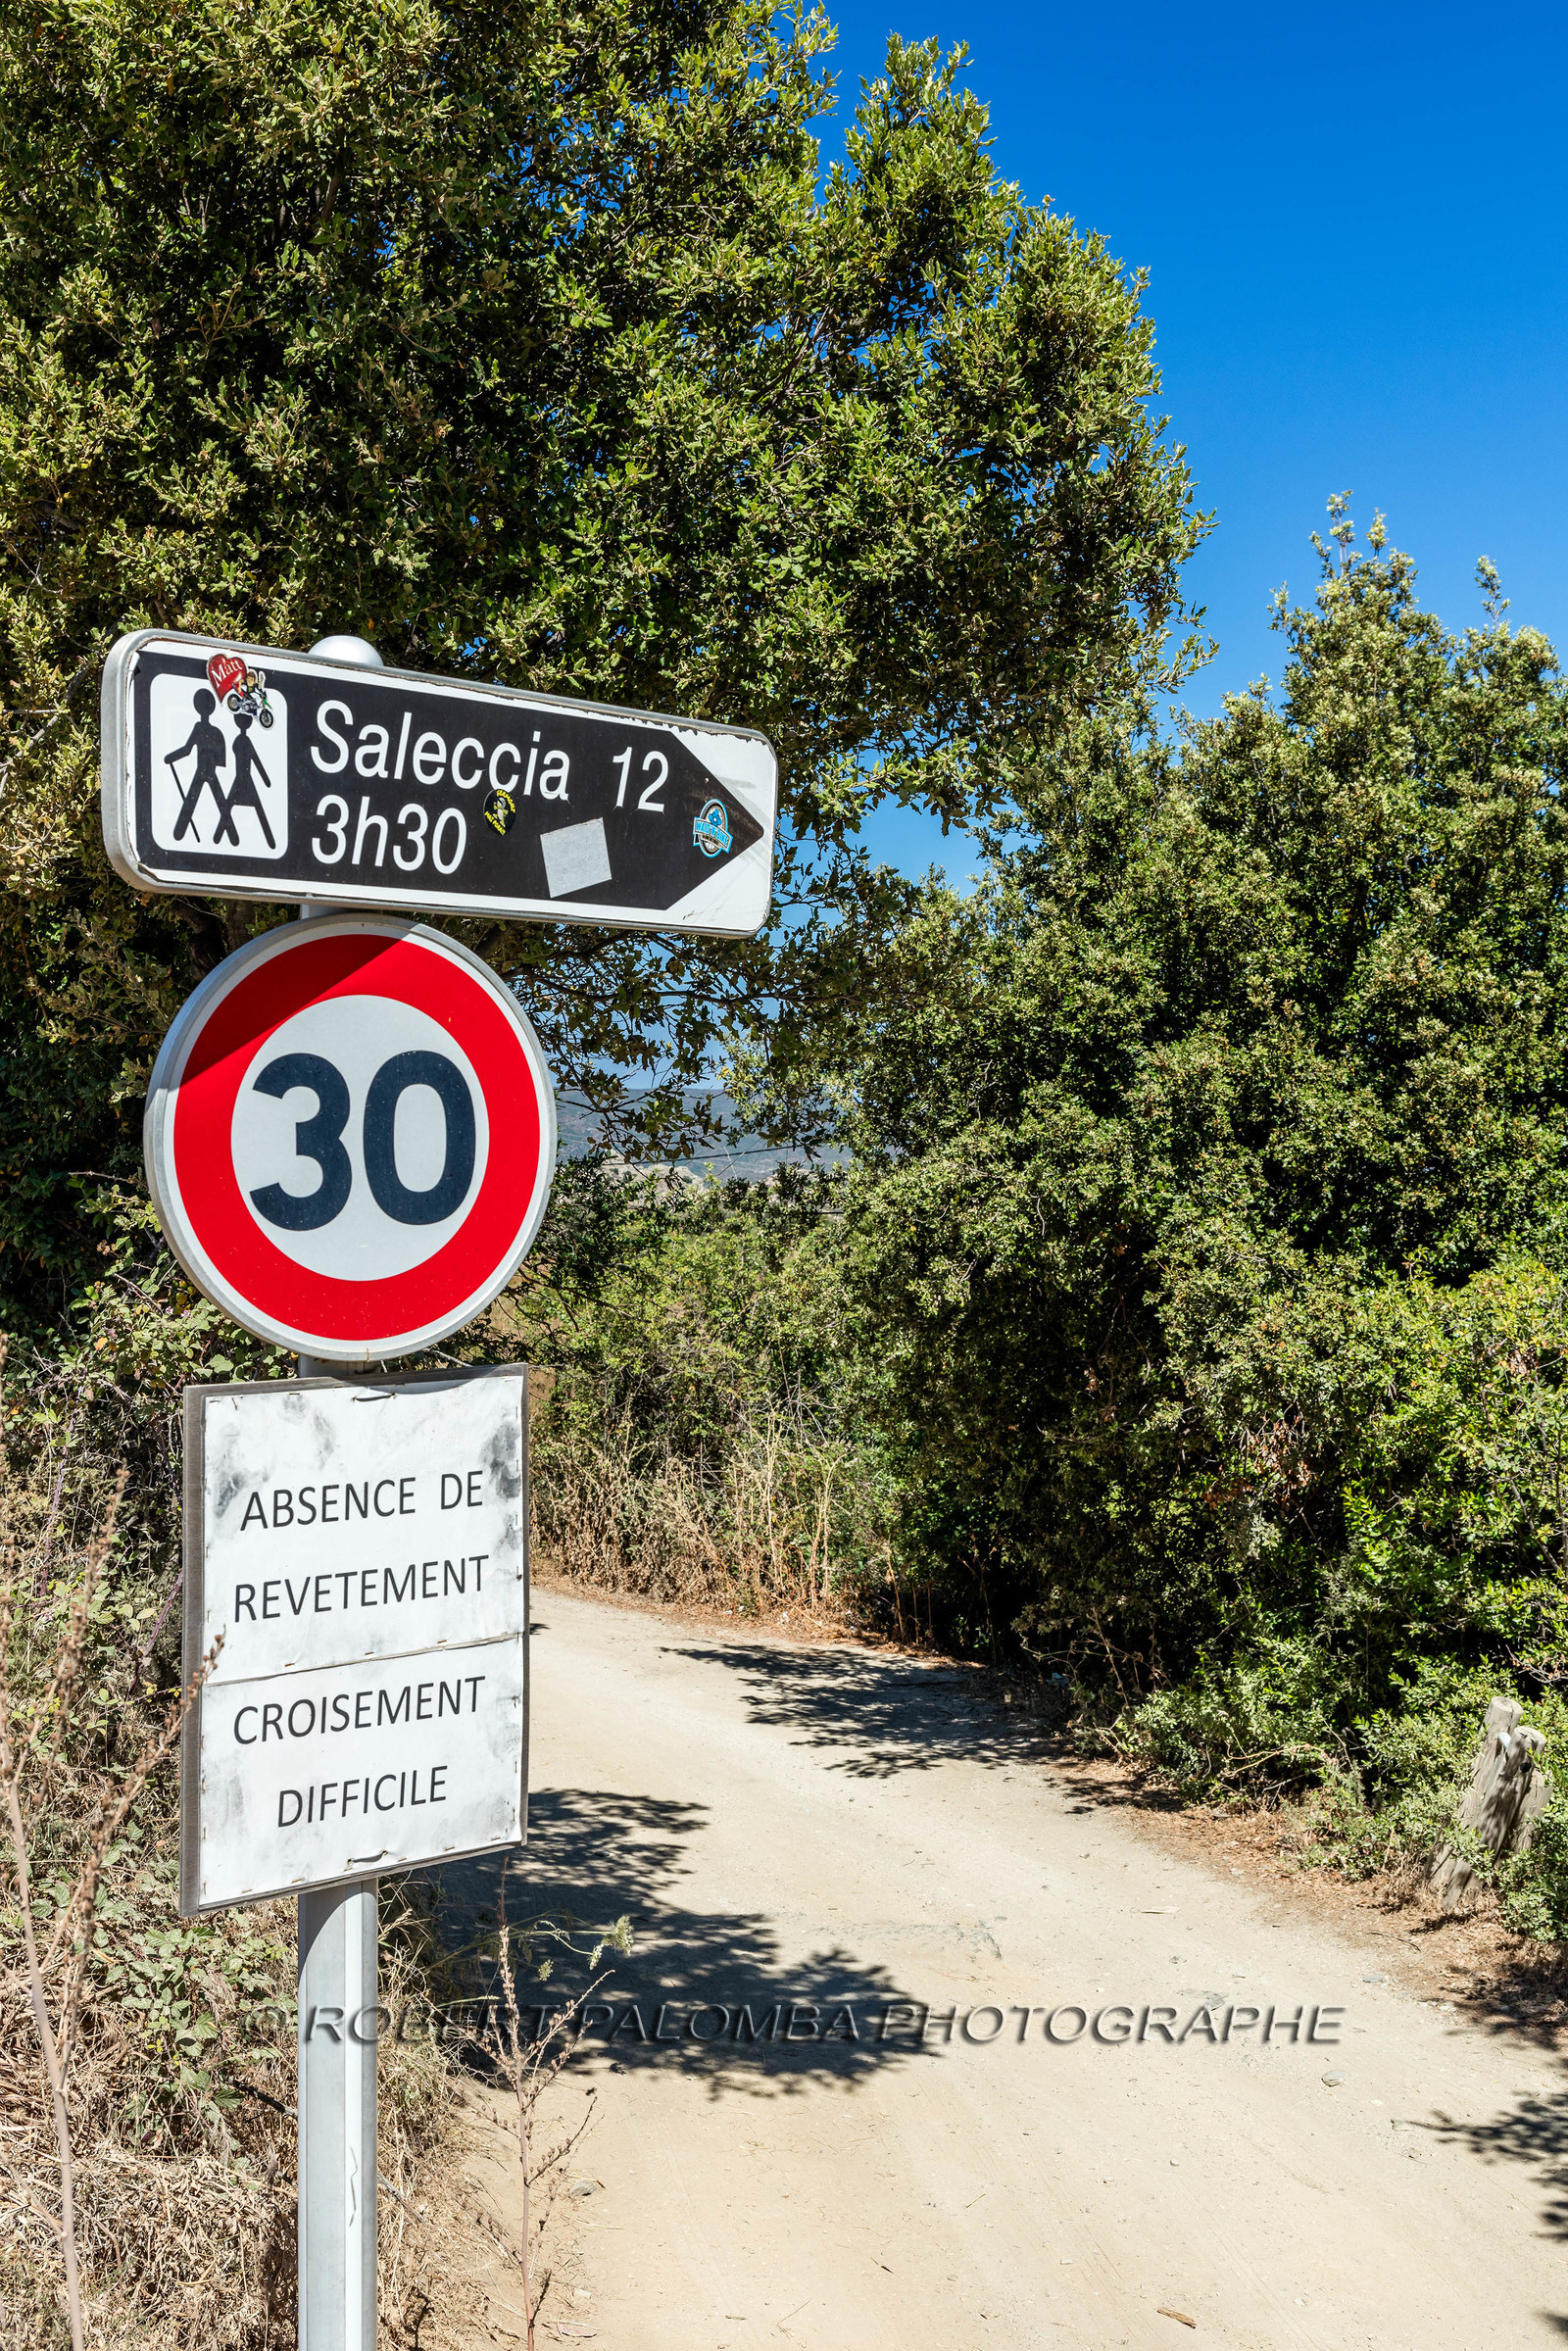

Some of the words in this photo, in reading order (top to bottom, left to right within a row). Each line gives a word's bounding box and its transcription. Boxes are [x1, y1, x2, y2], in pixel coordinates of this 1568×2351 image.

[211, 660, 242, 688] Matt
[311, 700, 569, 801] Saleccia
[612, 747, 668, 812] 12
[313, 795, 466, 874] 3h30
[249, 1050, 476, 1232] 30
[240, 1478, 416, 1532] ABSENCE
[441, 1470, 483, 1510] DE
[234, 1555, 489, 1623] REVETEMENT
[233, 1676, 486, 1745] CROISEMENT
[277, 1766, 448, 1828] DIFFICILE
